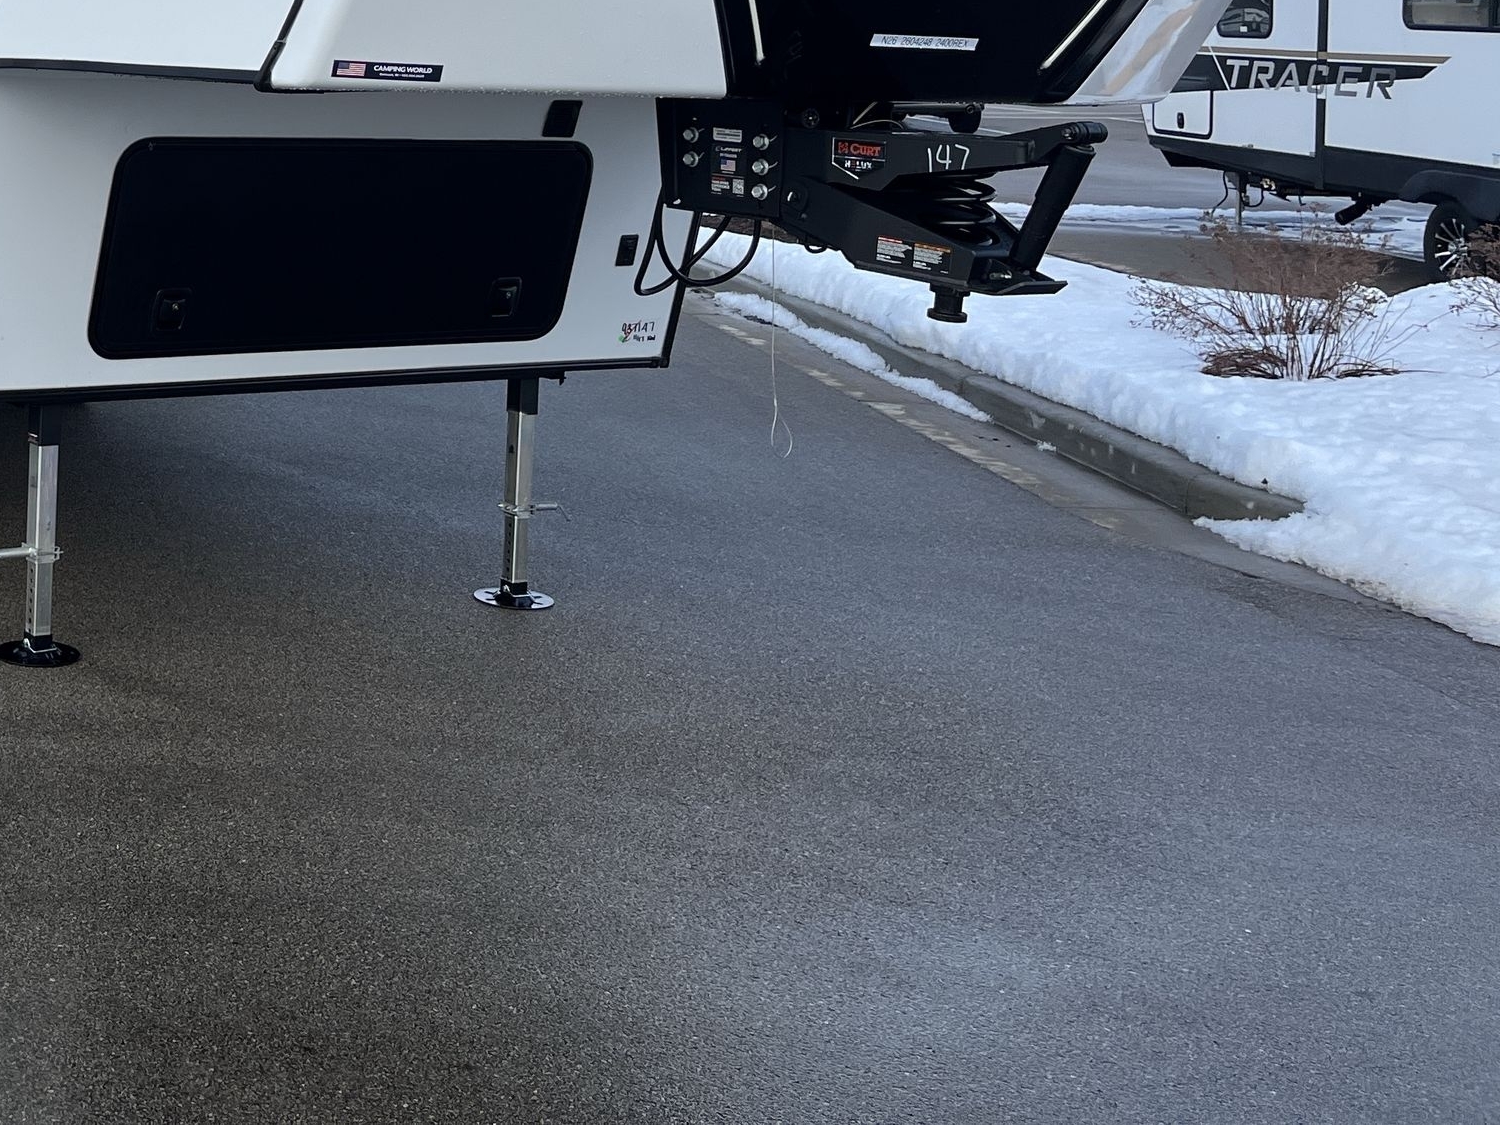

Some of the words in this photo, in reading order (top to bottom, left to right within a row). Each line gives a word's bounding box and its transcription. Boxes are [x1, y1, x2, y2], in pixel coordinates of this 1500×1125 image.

[373, 64, 406, 73] CAMPING
[406, 66, 433, 74] WORLD
[1226, 58, 1397, 100] TRACER
[850, 143, 882, 157] CURT
[927, 143, 970, 173] 147
